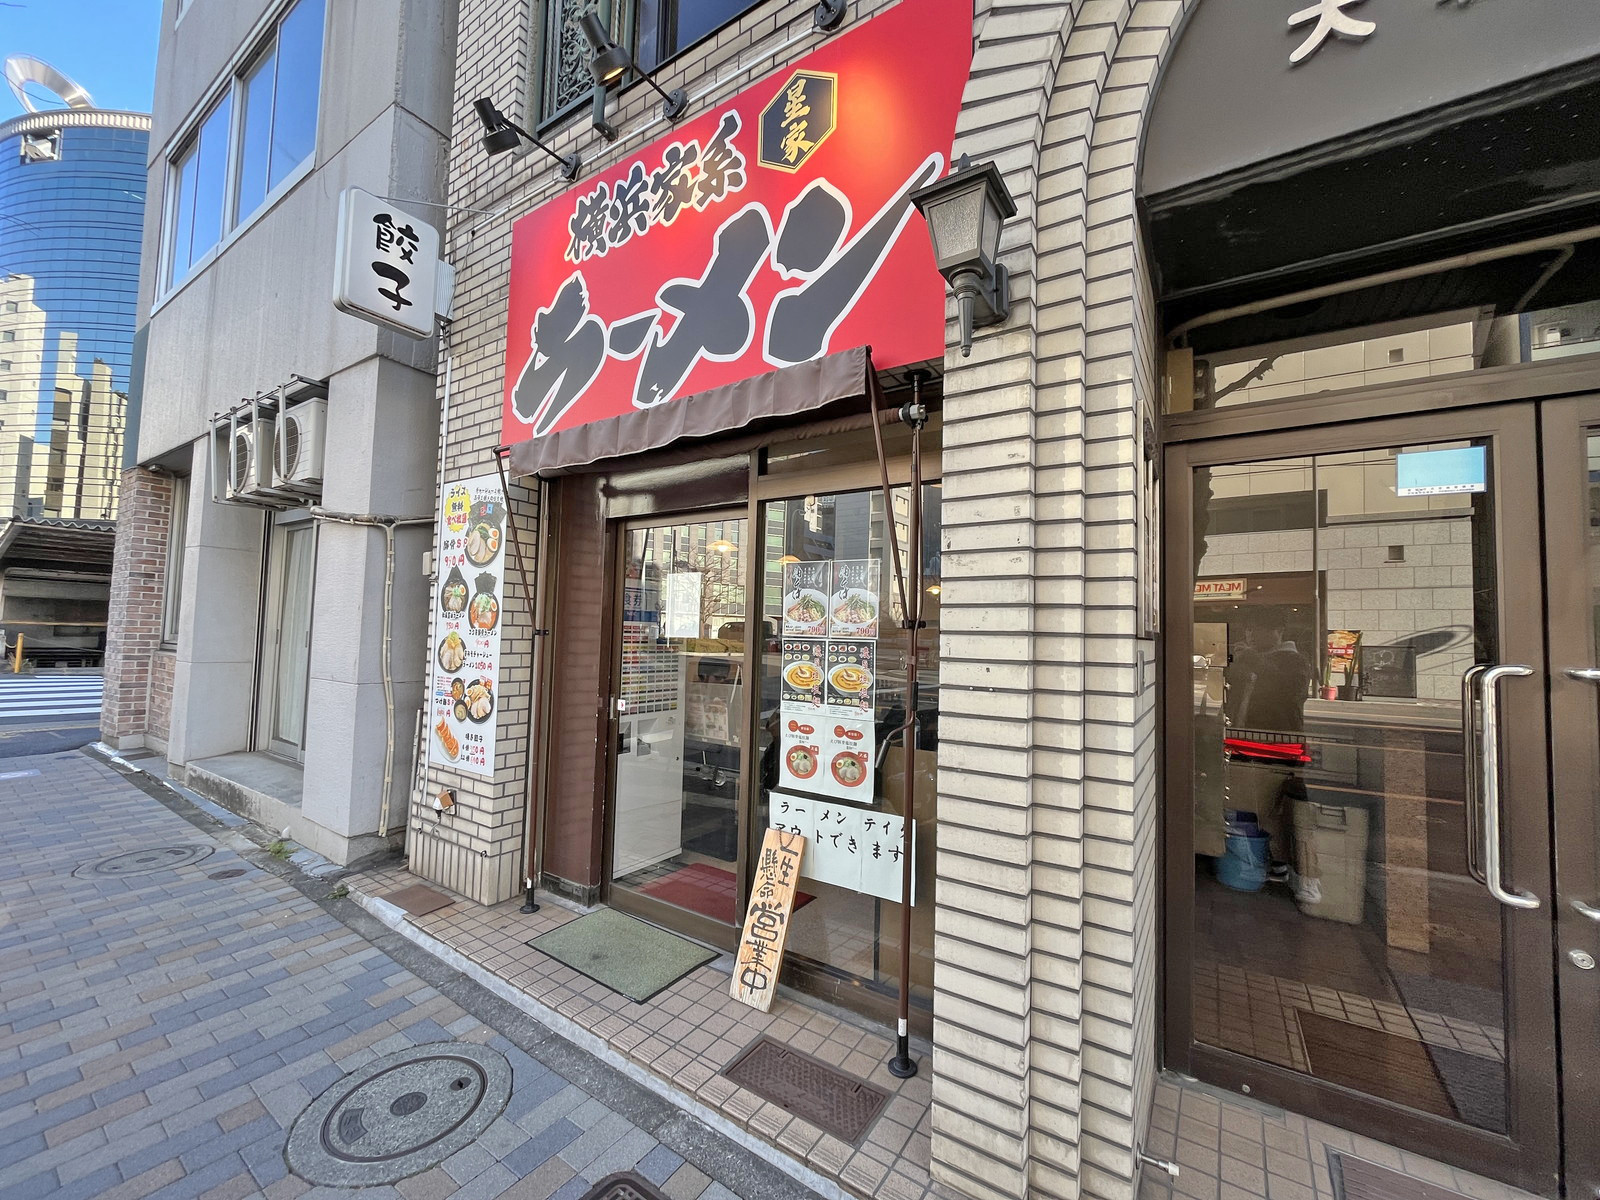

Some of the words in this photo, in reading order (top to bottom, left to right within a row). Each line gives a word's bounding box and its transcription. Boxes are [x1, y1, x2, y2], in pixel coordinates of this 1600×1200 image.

[780, 79, 815, 163] 星家
[565, 109, 747, 264] 横浜家系
[371, 213, 420, 311] 餃子
[511, 152, 944, 438] ラーメン
[450, 487, 467, 498] ライス
[740, 901, 785, 994] 営業中
